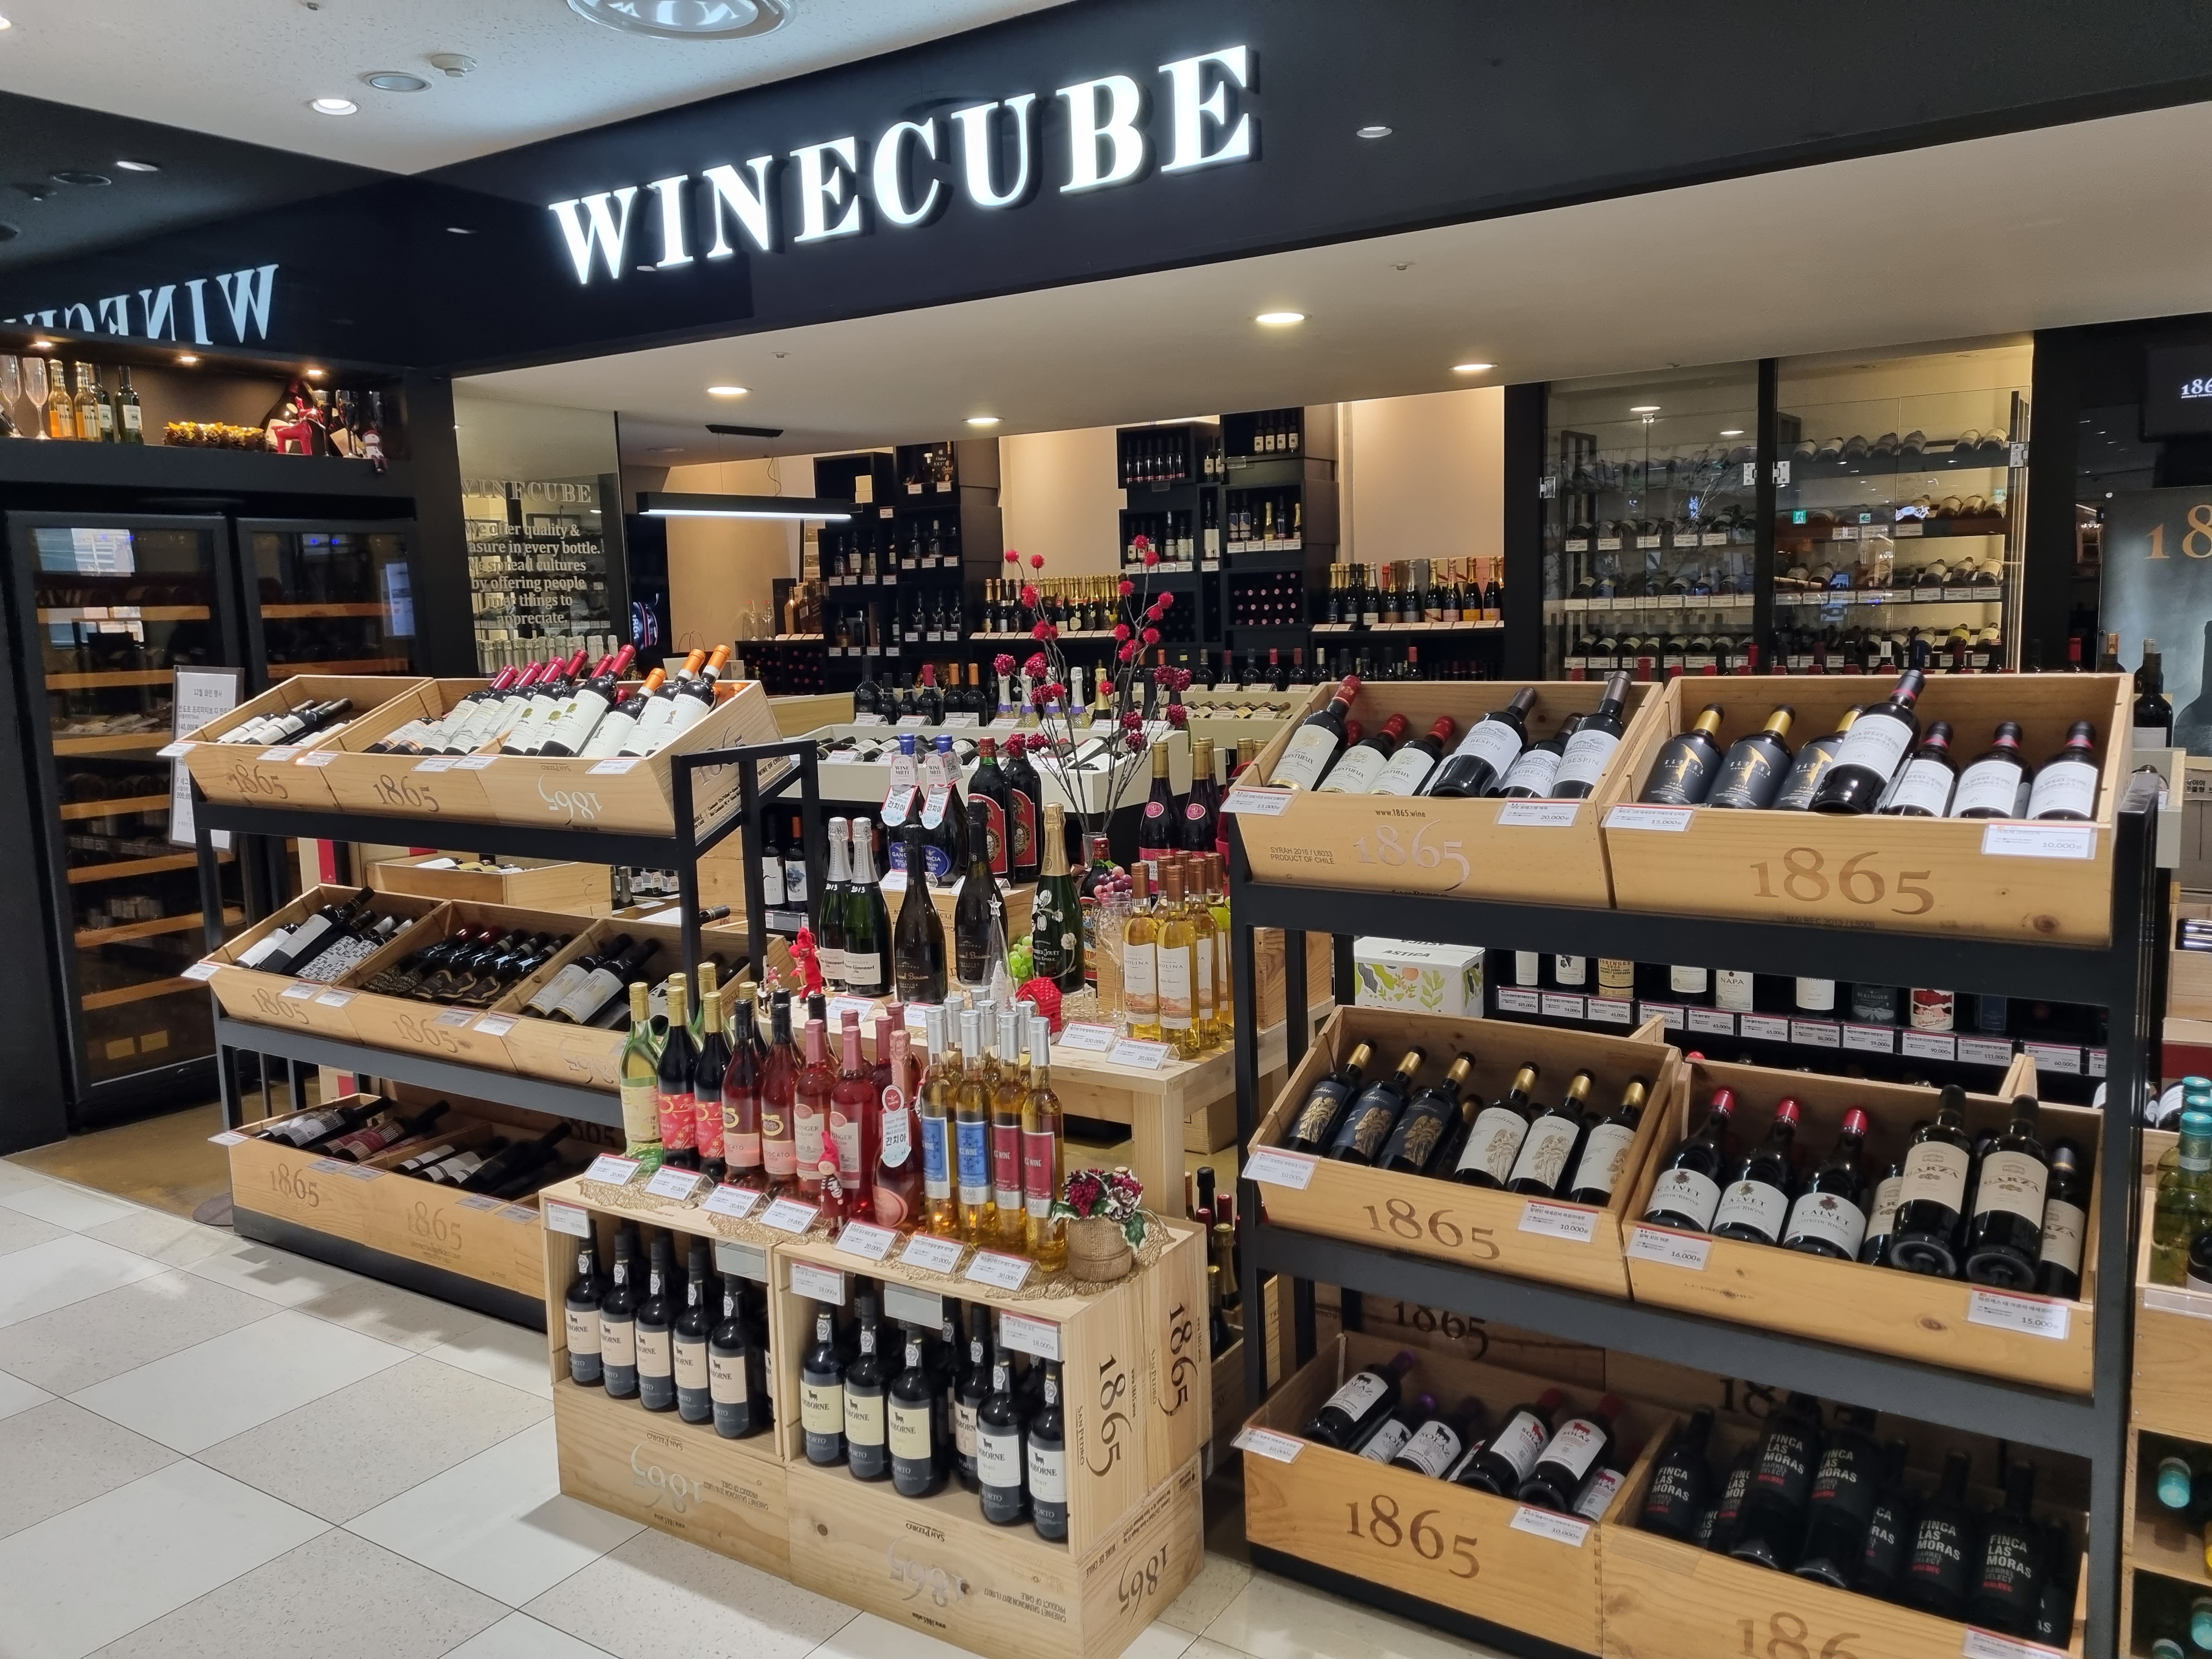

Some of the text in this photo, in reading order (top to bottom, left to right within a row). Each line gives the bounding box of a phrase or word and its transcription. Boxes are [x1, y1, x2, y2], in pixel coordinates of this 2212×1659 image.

[549, 45, 1251, 284] WINECUBE
[490, 522, 521, 535] offer
[524, 523, 567, 539] quality
[569, 524, 580, 537] &
[509, 541, 522, 553] in
[524, 544, 559, 556] every
[562, 541, 600, 554] bottle.
[488, 557, 534, 574] spread
[536, 559, 586, 572] cultures
[471, 577, 586, 592] by offering people
[518, 592, 557, 608] things
[560, 594, 573, 606] to
[496, 612, 568, 627] appreciate.
[758, 766, 768, 777] WINE
[1664, 759, 1704, 776] ELDORA
[1730, 759, 1771, 778] ELDORA
[227, 764, 289, 800] 1865
[373, 774, 440, 812] 1865
[538, 773, 602, 826] 1865
[1375, 809, 1426, 819] www.1865.wine
[1271, 847, 1333, 857] SYRAH 2016 L8033
[2042, 842, 2083, 850] 10,000원
[1270, 854, 1302, 863] PRODUCT
[1314, 856, 1335, 865] CHILE
[1353, 820, 1471, 892] 1865
[1750, 847, 1935, 915] 1865
[850, 885, 866, 894] 2013
[1382, 949, 1431, 959] ASTICA
[1720, 977, 1745, 986] NAPA
[251, 988, 310, 1025] 1865
[392, 1014, 459, 1053] 1865
[885, 1134, 907, 1147] 간치아
[1280, 1172, 1304, 1182] 10,000원
[269, 1163, 320, 1209] 1865
[1657, 1184, 1702, 1198] CALVET
[1722, 1196, 1767, 1208] CALVET
[406, 1201, 462, 1251] 1865
[1801, 1210, 1850, 1226] CALVET
[1363, 1198, 1500, 1260] 1865
[1560, 1224, 1589, 1234] 10,000원
[864, 1243, 883, 1253] 20,000원
[931, 1255, 952, 1266] 30,000원
[1671, 1251, 1701, 1262] 16,000원
[997, 1272, 1019, 1284] 30,000원
[818, 1286, 837, 1296] 18,000원
[1392, 1301, 1489, 1361] 1865
[2021, 1317, 2059, 1329] 15,000원
[1032, 1340, 1055, 1351] 18,000원
[1158, 1302, 1199, 1417] 1865
[802, 1398, 830, 1411] OSBORNE
[1086, 1353, 1133, 1477] 1865
[646, 1432, 683, 1451] SAN PEDRO
[805, 1435, 826, 1446] PORTO
[1561, 1430, 1591, 1444] SOLAZ
[1769, 1434, 1803, 1451] FINCA
[977, 1445, 1006, 1462] OSBORNE
[1767, 1443, 1788, 1454] LAS
[892, 1462, 911, 1475] PORTO
[1029, 1461, 1057, 1477] OSBORNE
[1764, 1452, 1805, 1475] MORAS
[630, 1441, 704, 1514] 1865
[1655, 1475, 1673, 1485] LAS
[1657, 1466, 1688, 1481] FINCA
[1817, 1467, 1857, 1483] MORAS
[740, 1487, 758, 1499] PRODUCT
[981, 1489, 1003, 1502] PORTO
[1652, 1485, 1690, 1502] MORAS
[1034, 1505, 1055, 1519] PORTO
[905, 1522, 945, 1542] SAN PEDRO
[1346, 1494, 1480, 1577] 1865
[1920, 1519, 1957, 1537] FINCA
[1104, 1543, 1118, 1560] WINE
[1916, 1538, 1961, 1561] MORAS
[1987, 1544, 2012, 1557] LAS
[1989, 1534, 2028, 1554] FINCA
[888, 1536, 967, 1609] 1865
[1987, 1554, 2032, 1579] MORAS
[1118, 1542, 1169, 1627] 1865
[1013, 1599, 1041, 1616] SAUVIGNON
[1021, 1592, 1066, 1615] PRODUCT OF CHILE
[1041, 1607, 1067, 1624] CABERNET
